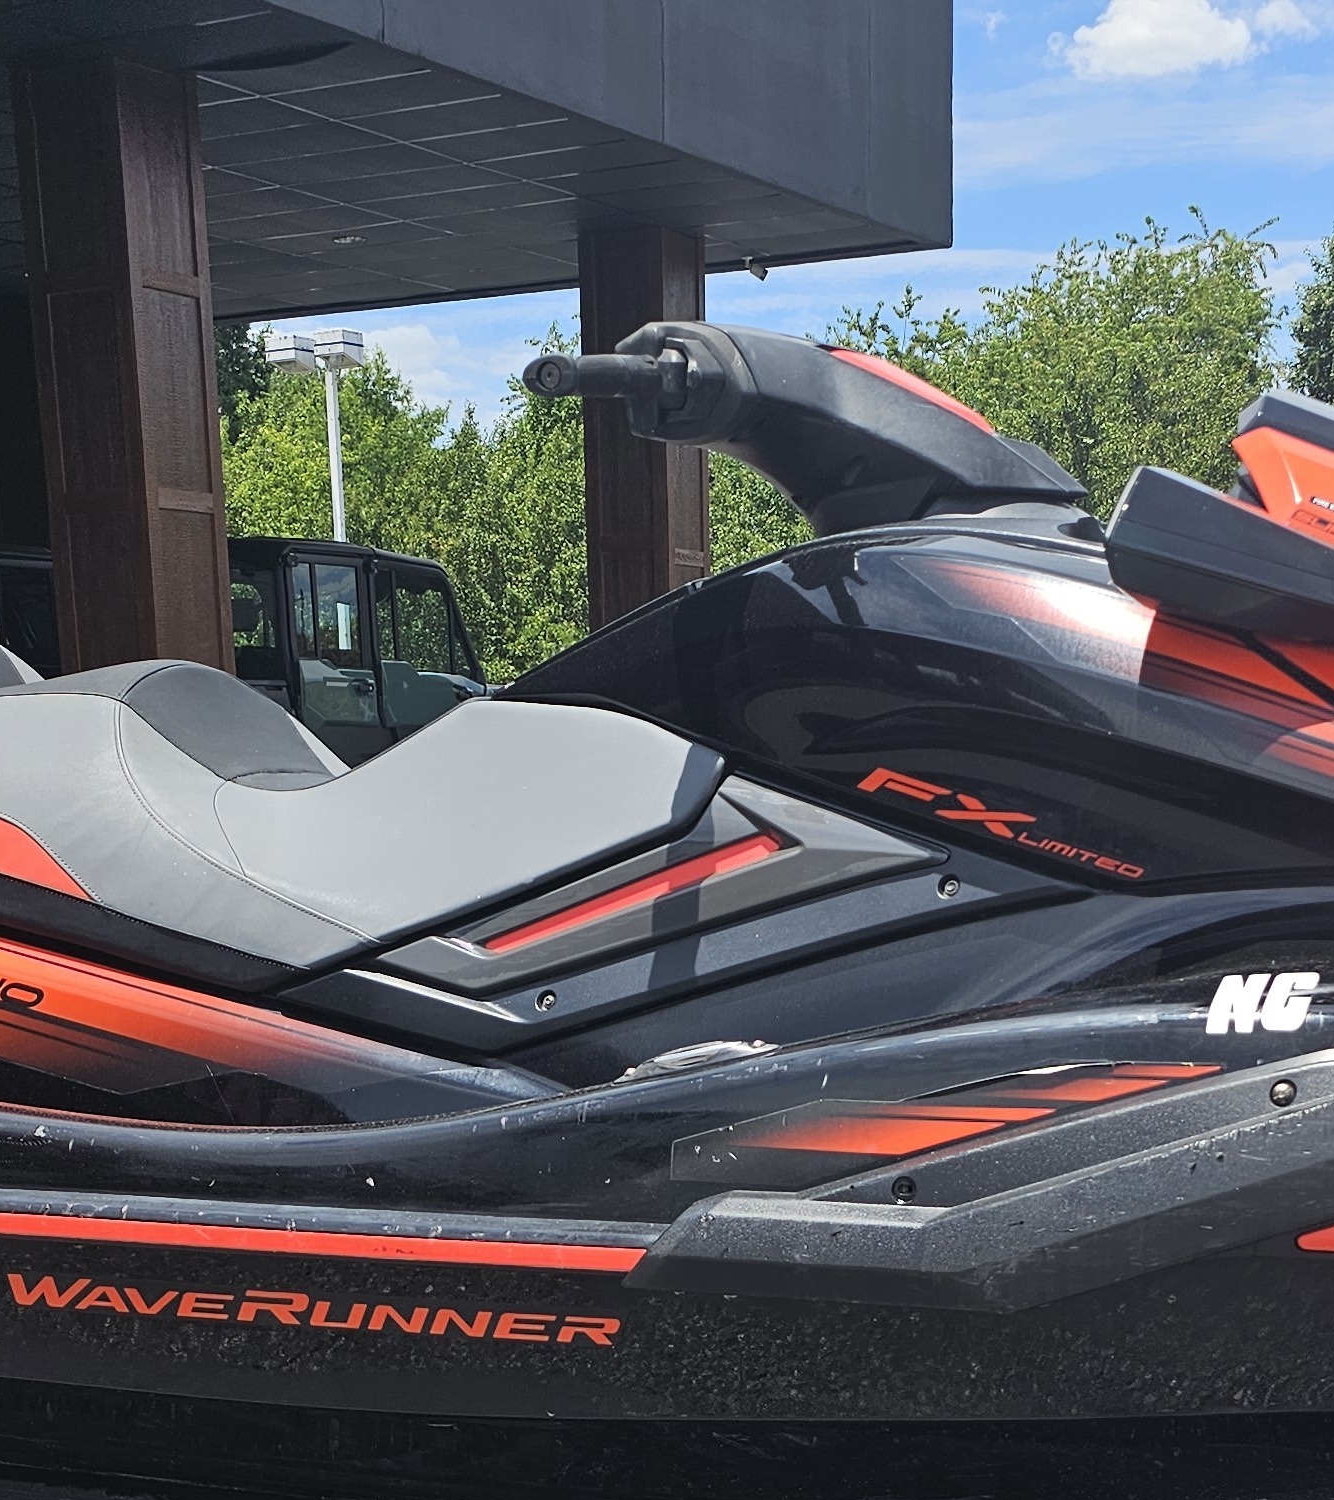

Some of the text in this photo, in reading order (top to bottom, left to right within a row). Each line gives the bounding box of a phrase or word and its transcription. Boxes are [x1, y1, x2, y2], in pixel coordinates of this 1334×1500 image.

[856, 767, 1145, 879] FX LIMITED
[1205, 972, 1321, 1034] NC
